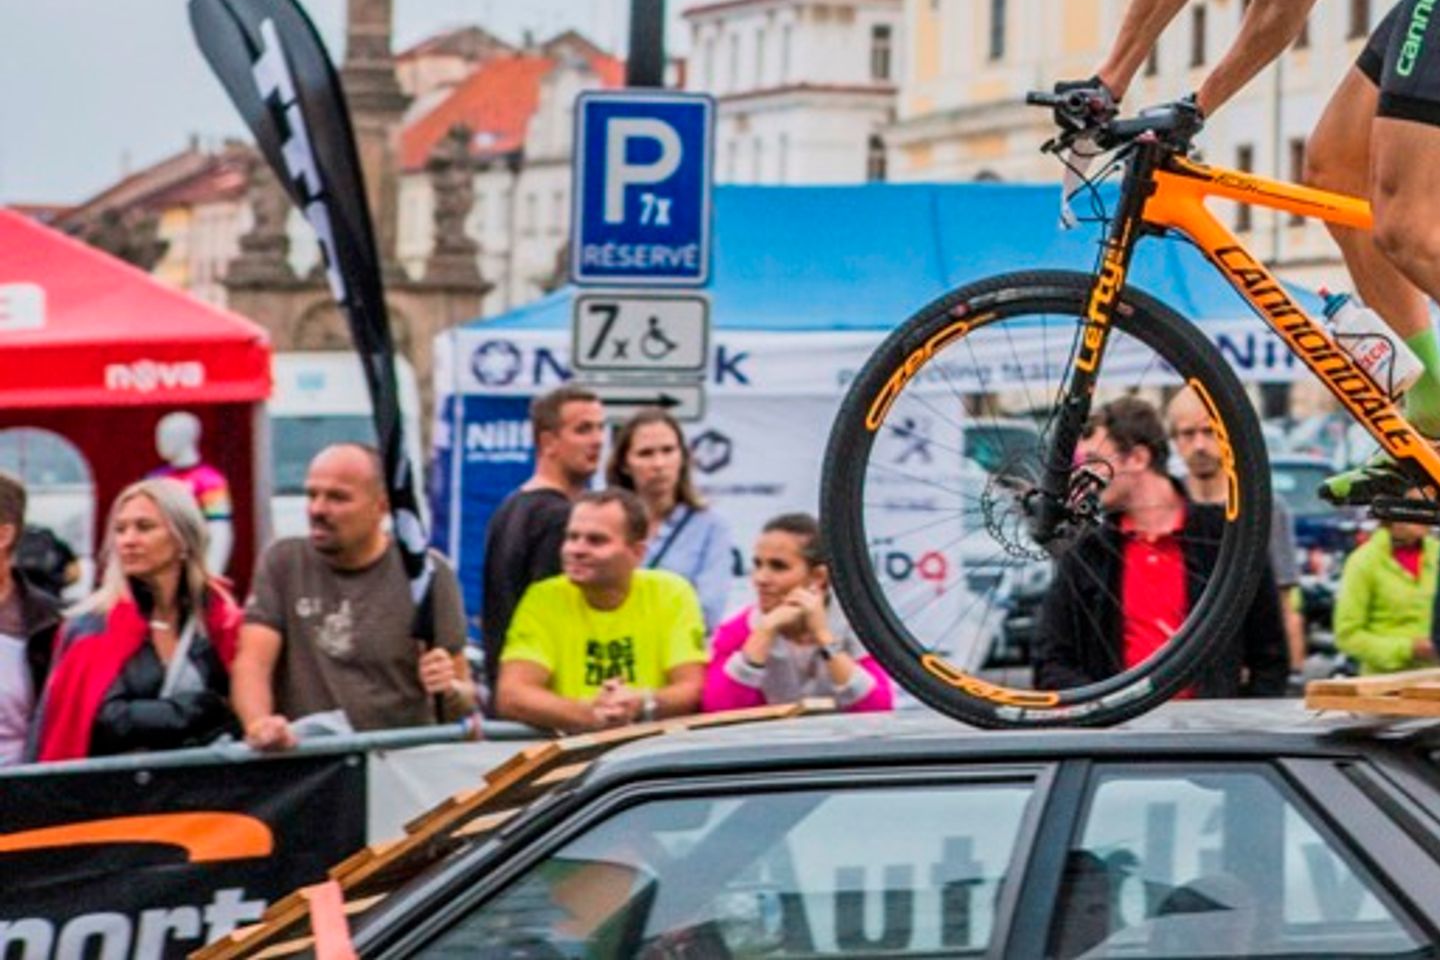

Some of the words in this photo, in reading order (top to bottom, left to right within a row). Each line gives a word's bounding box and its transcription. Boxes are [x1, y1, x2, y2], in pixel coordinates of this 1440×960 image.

[604, 117, 683, 225] P
[583, 243, 699, 269] RÉSERVÉ
[1075, 258, 1125, 374] Lefty
